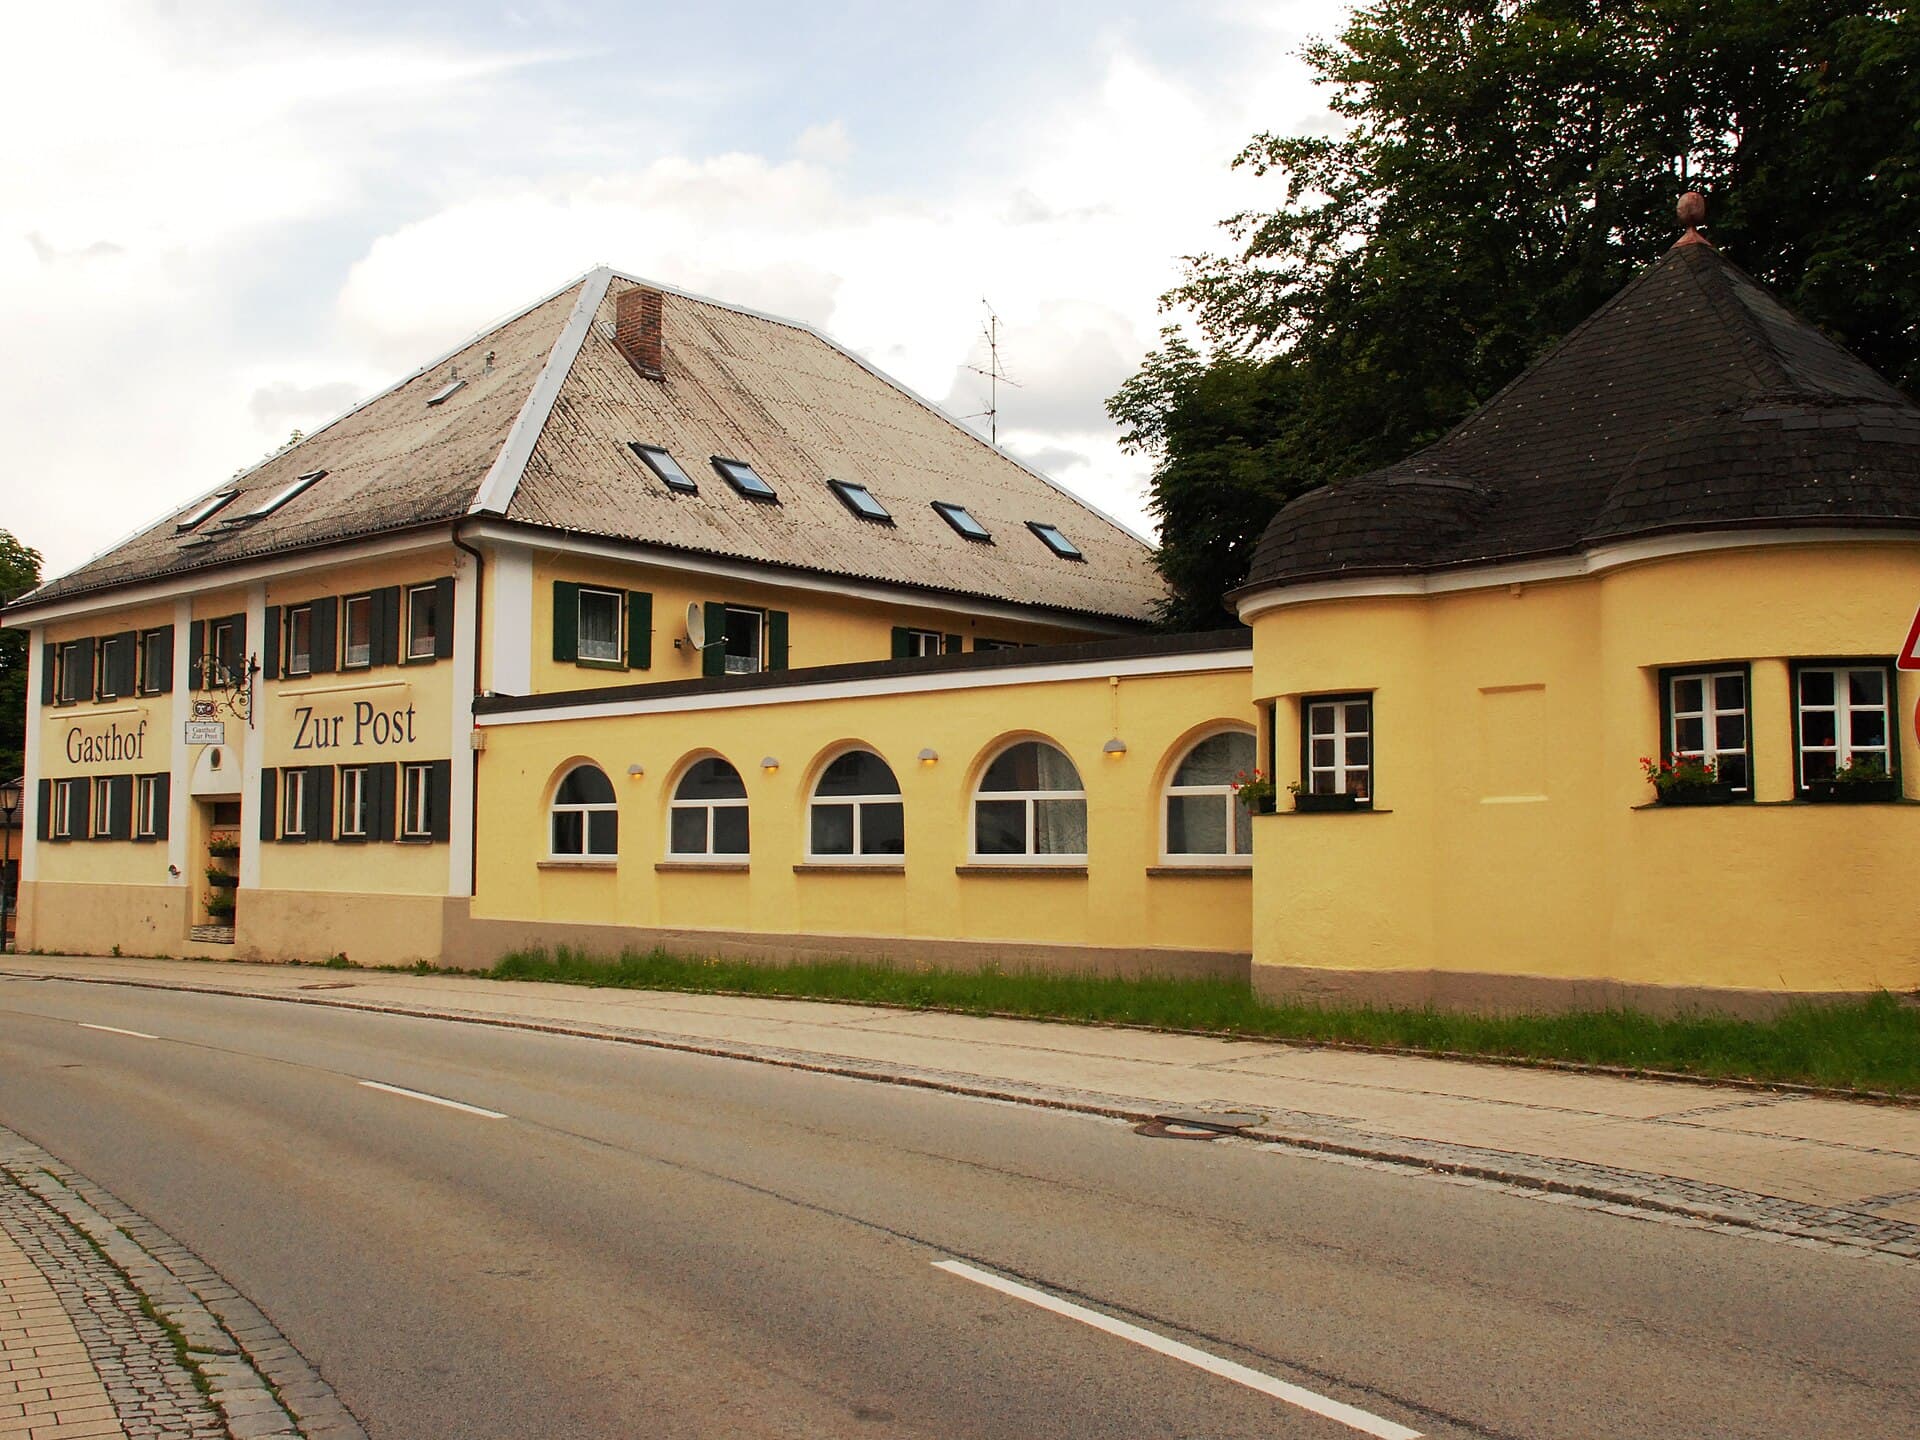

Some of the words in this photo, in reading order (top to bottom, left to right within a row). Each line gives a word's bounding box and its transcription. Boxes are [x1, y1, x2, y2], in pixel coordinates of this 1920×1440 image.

[66, 720, 146, 764] Gasthof
[293, 707, 344, 750] Zur
[353, 702, 416, 746] Post
